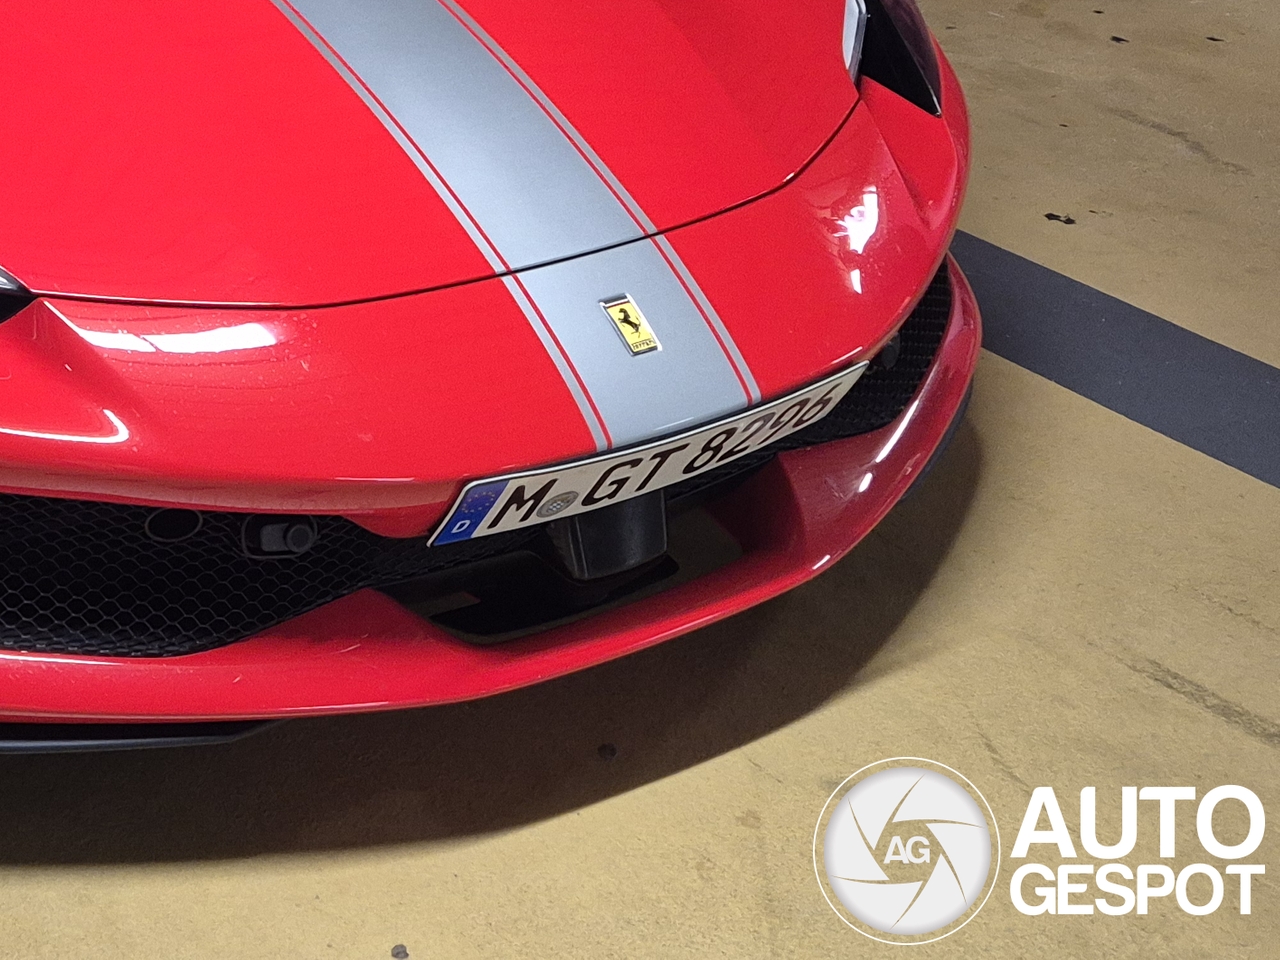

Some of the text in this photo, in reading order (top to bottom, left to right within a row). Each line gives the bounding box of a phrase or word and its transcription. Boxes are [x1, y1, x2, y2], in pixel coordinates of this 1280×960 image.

[488, 382, 844, 529] M GT 8296
[451, 519, 470, 534] D
